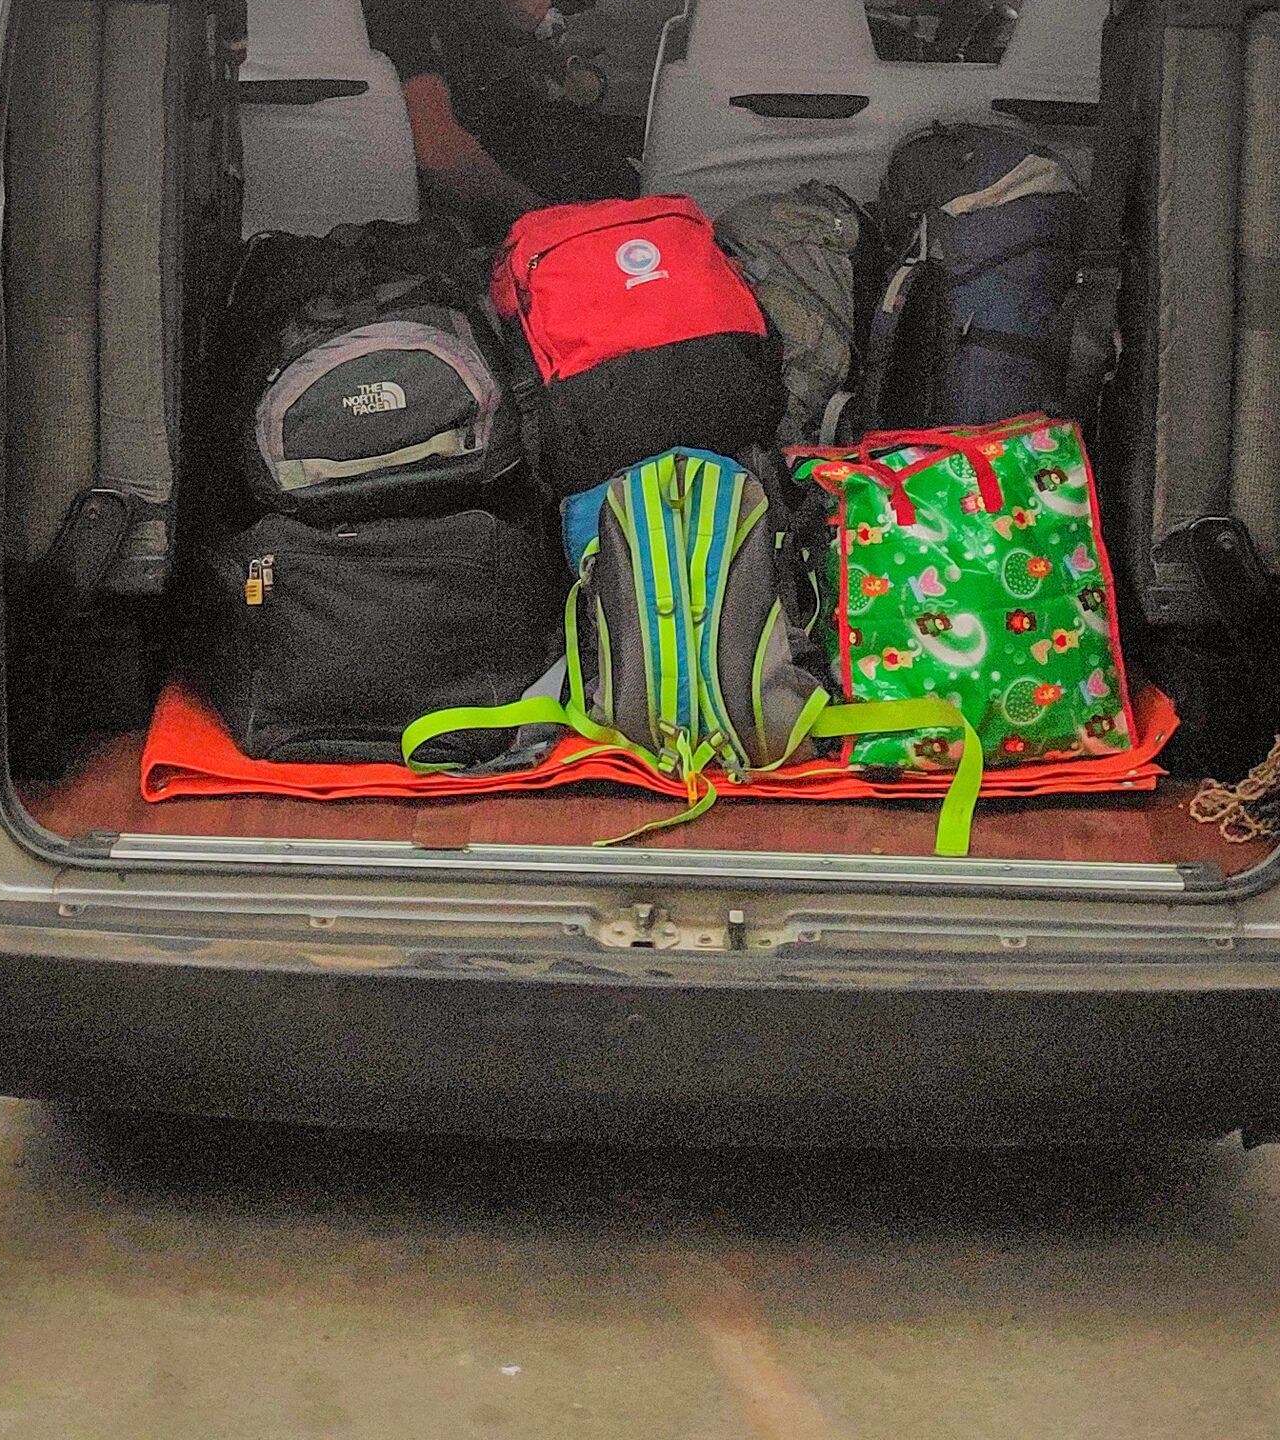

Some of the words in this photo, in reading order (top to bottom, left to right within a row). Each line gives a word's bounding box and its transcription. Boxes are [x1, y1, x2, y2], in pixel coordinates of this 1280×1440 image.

[357, 382, 383, 395] THE
[342, 392, 384, 408] NORTH
[353, 402, 386, 416] FACE
